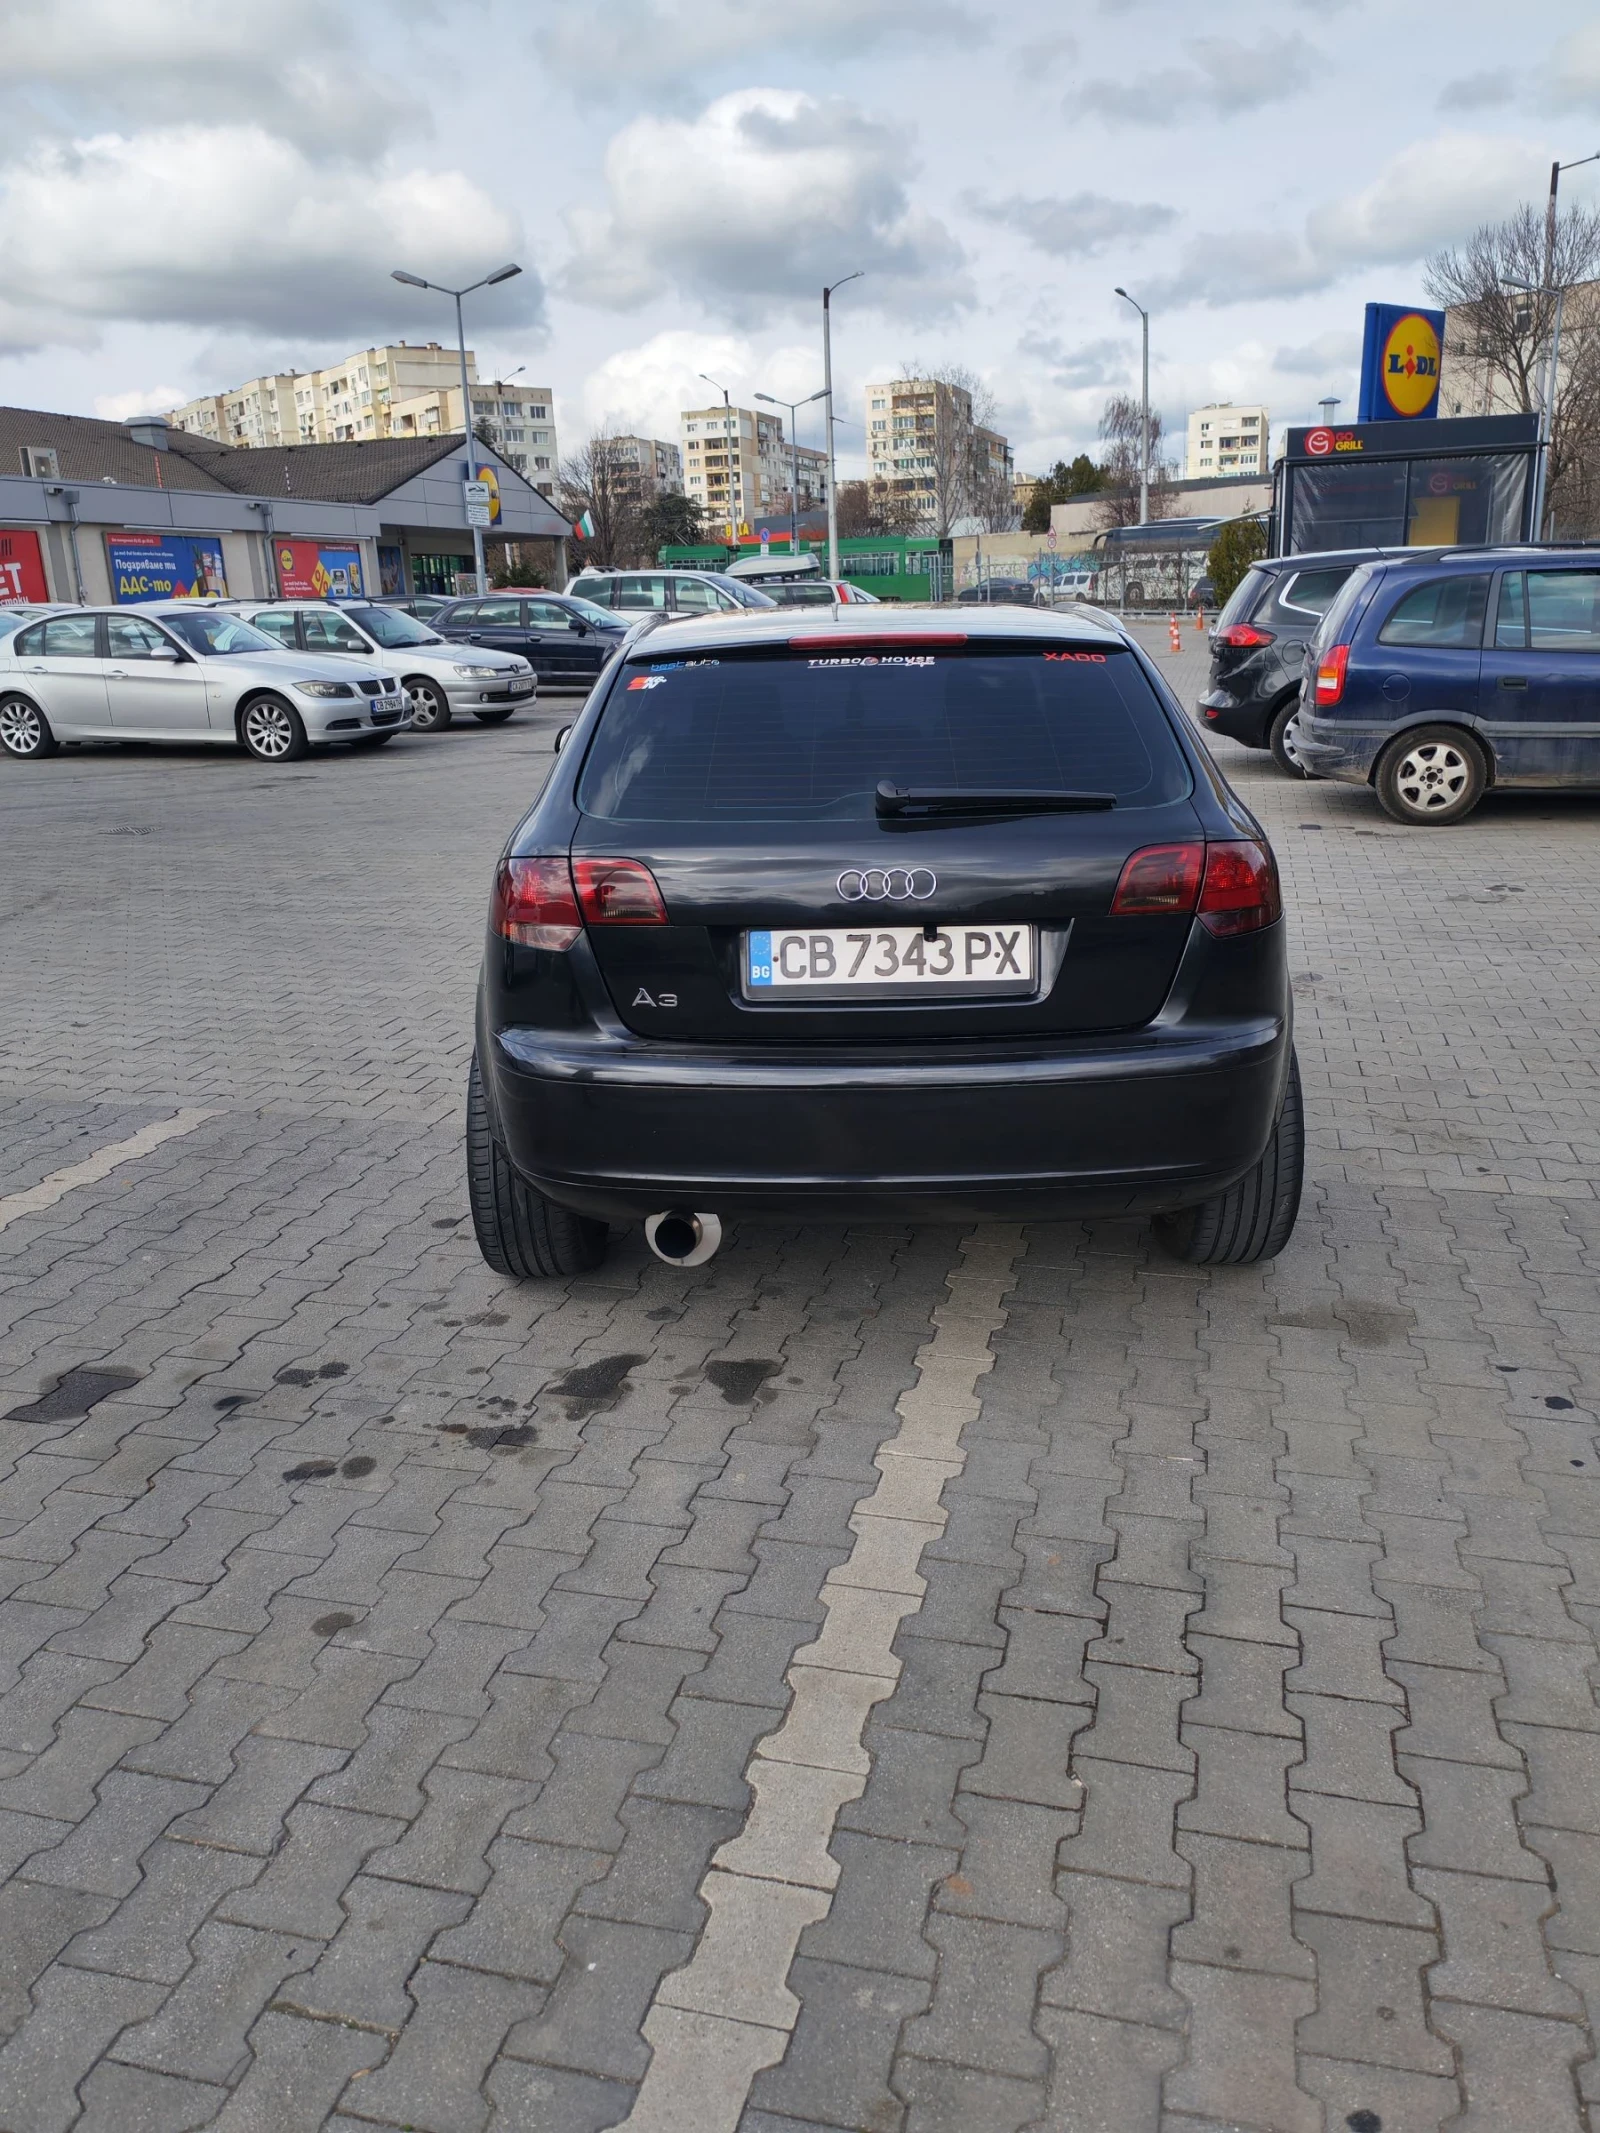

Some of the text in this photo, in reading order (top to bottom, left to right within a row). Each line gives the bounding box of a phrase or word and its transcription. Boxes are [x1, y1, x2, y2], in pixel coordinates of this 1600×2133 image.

[1335, 431, 1354, 441] GO
[1335, 440, 1363, 451] GRILL
[120, 575, 172, 595] ДДС-то
[808, 656, 935, 666] TURBO HOUSE
[1042, 652, 1106, 663] XADO
[779, 931, 1022, 979] CB 7343 PX
[752, 965, 770, 979] BG
[631, 987, 678, 1007] A3
